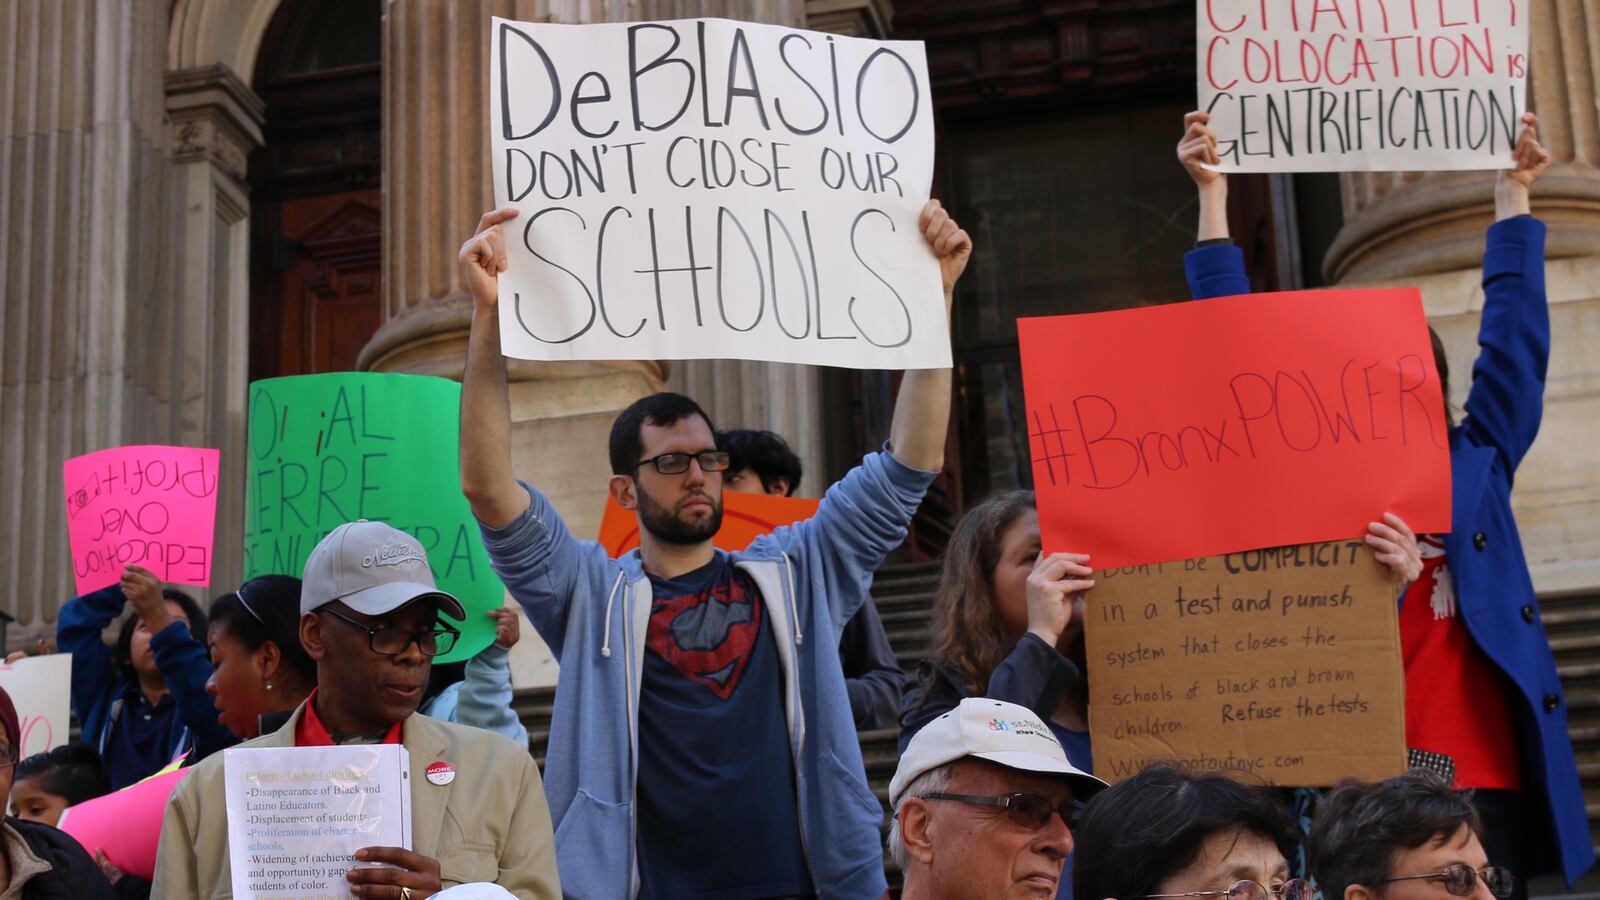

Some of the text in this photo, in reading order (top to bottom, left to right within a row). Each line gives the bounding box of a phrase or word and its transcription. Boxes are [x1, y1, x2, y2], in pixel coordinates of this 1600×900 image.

[1207, 28, 1494, 90] COLOCATION
[1203, 85, 1518, 166] GENTRIFICATION
[506, 136, 903, 201] DON'T CLOSE OUR
[514, 205, 912, 348] SCHOOLS
[102, 457, 215, 498] Profit
[92, 501, 169, 541] Over
[74, 539, 206, 581] Education
[1223, 541, 1363, 575] COMPLICIT
[1102, 583, 1353, 624] in a test and punish
[1107, 626, 1336, 670] system that closes the
[1113, 666, 1355, 706] schools of black and brown
[1222, 703, 1282, 724] Refuse
[1296, 697, 1325, 718] the
[246, 800, 328, 811] Latino Educators.
[320, 786, 331, 795] of
[311, 827, 321, 837] of
[316, 812, 327, 823] of
[248, 867, 265, 878] and
[267, 866, 326, 881] opportunity)
[300, 854, 310, 863] of
[248, 879, 328, 891] students of color.
